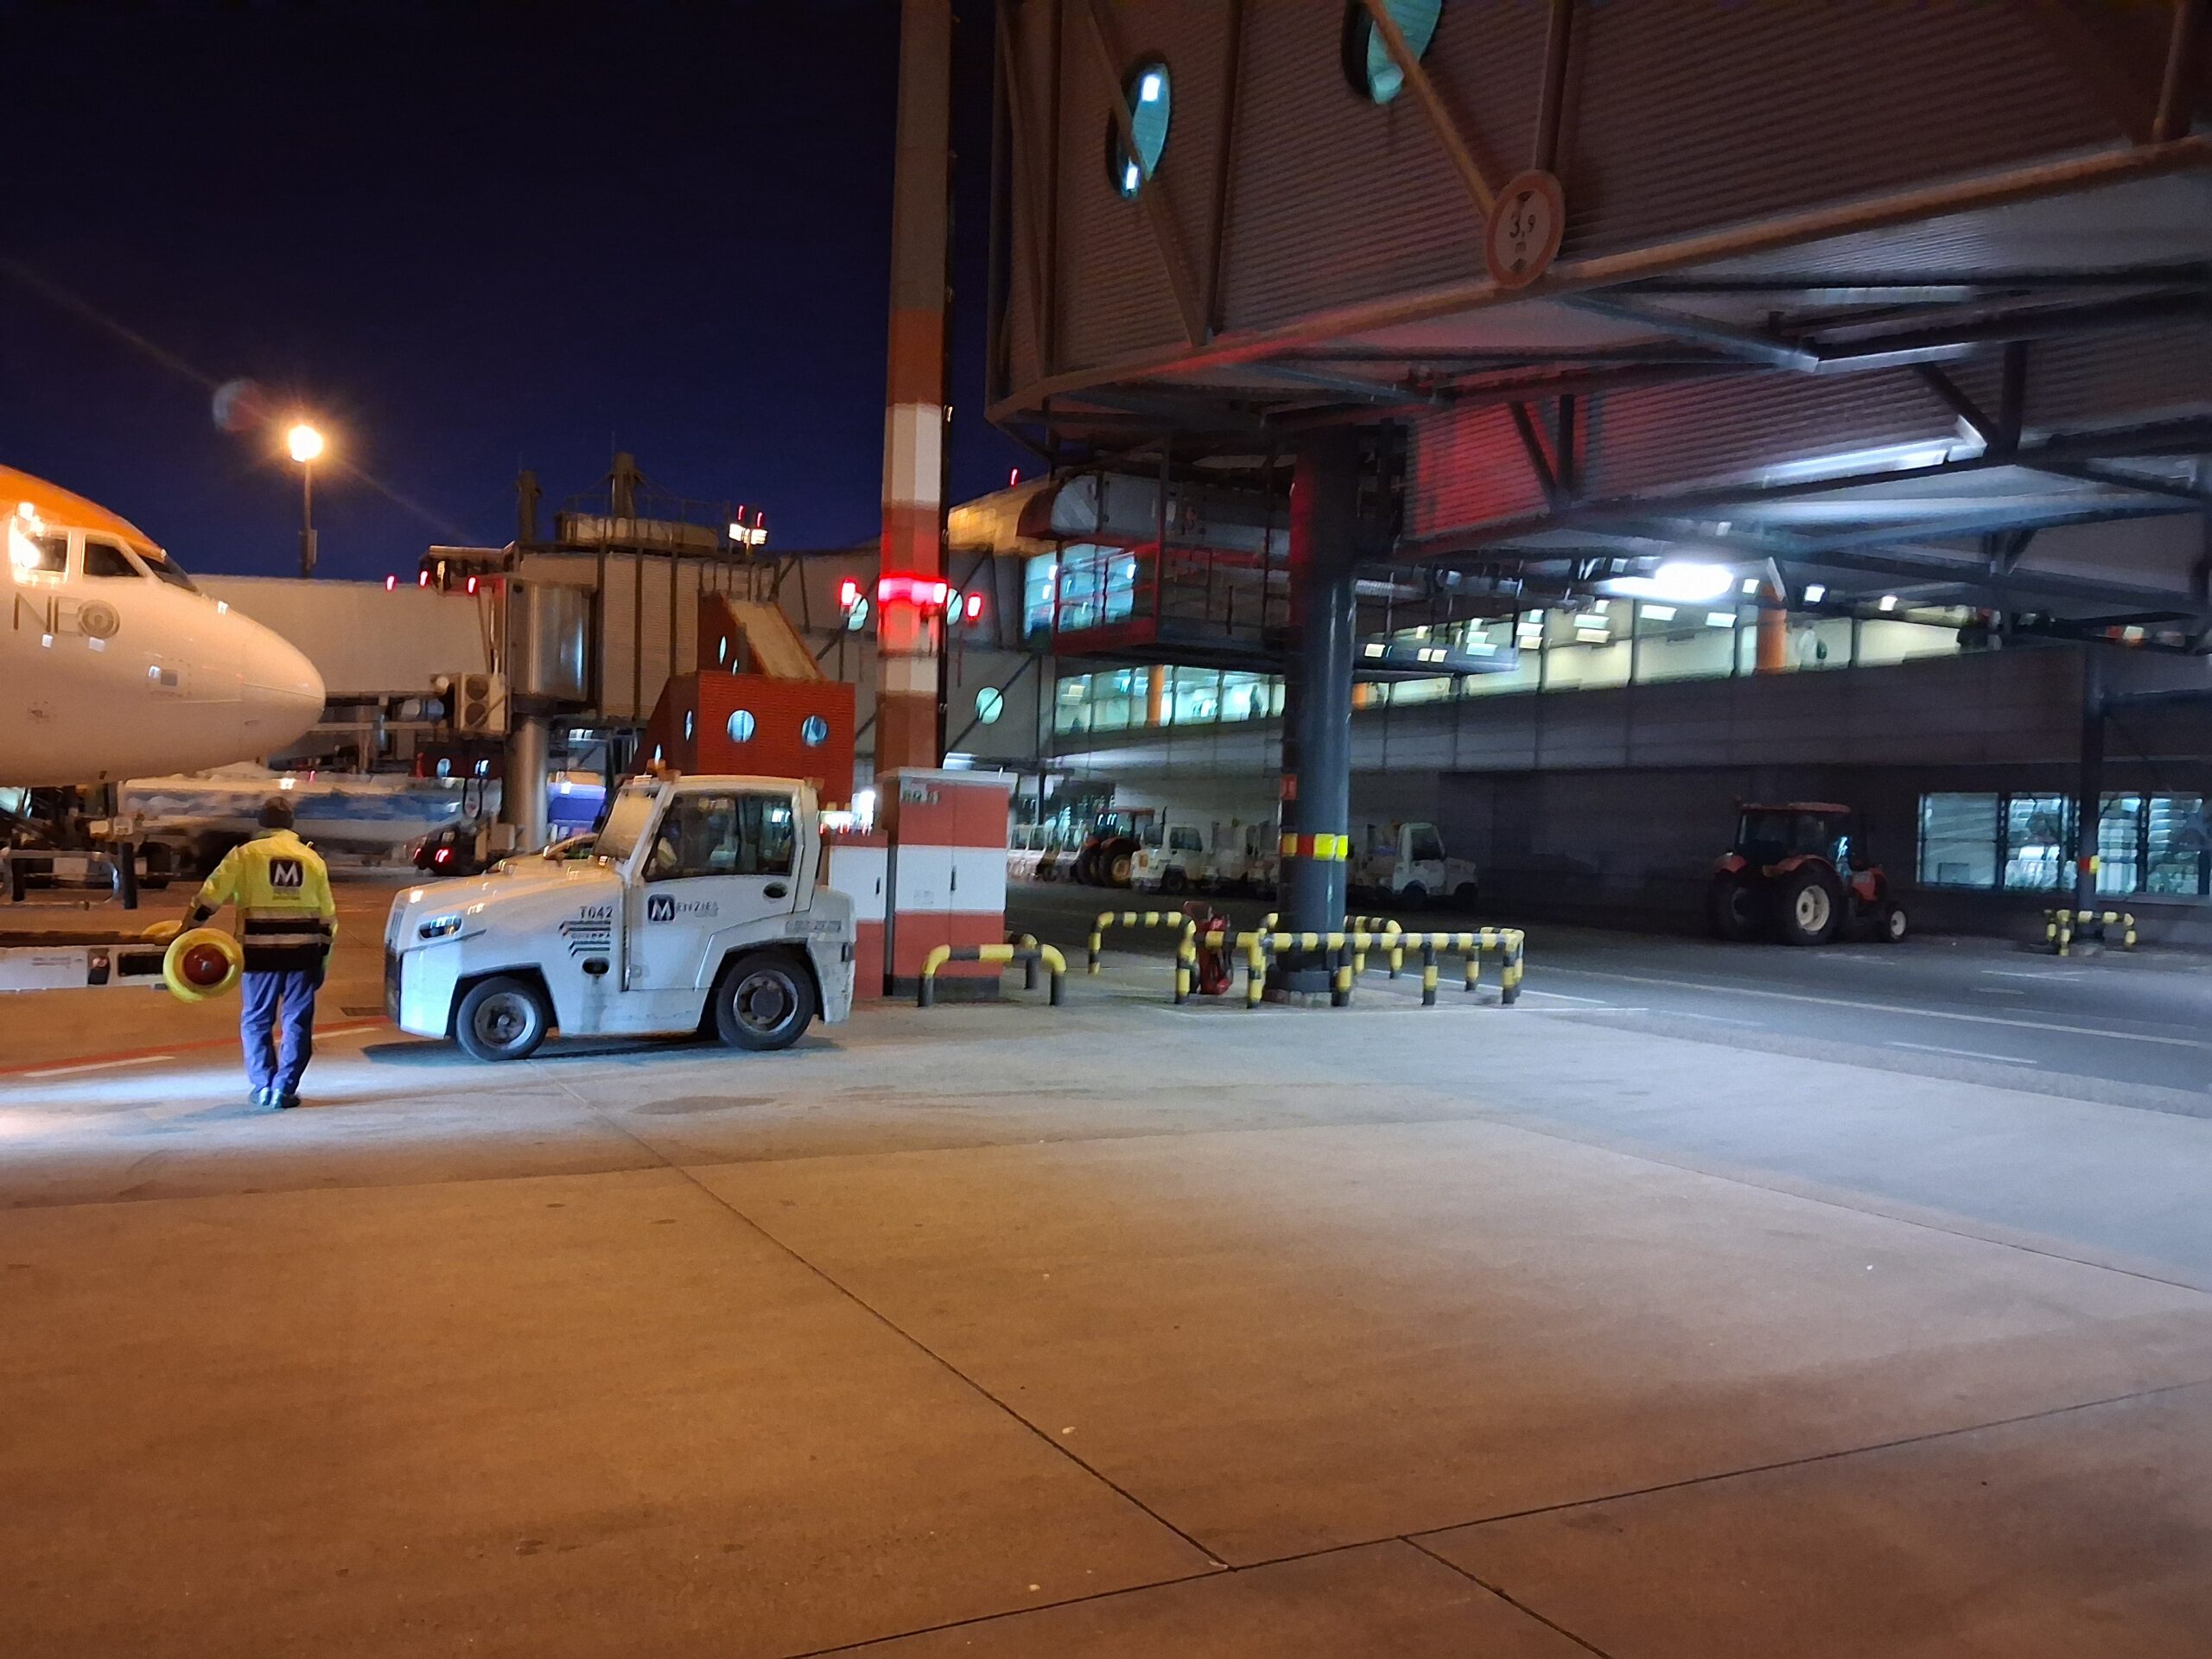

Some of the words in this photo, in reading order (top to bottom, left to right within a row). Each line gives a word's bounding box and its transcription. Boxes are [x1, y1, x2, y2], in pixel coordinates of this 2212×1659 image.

[13, 592, 121, 639] NEO
[273, 861, 299, 886] M
[580, 906, 613, 919] T042
